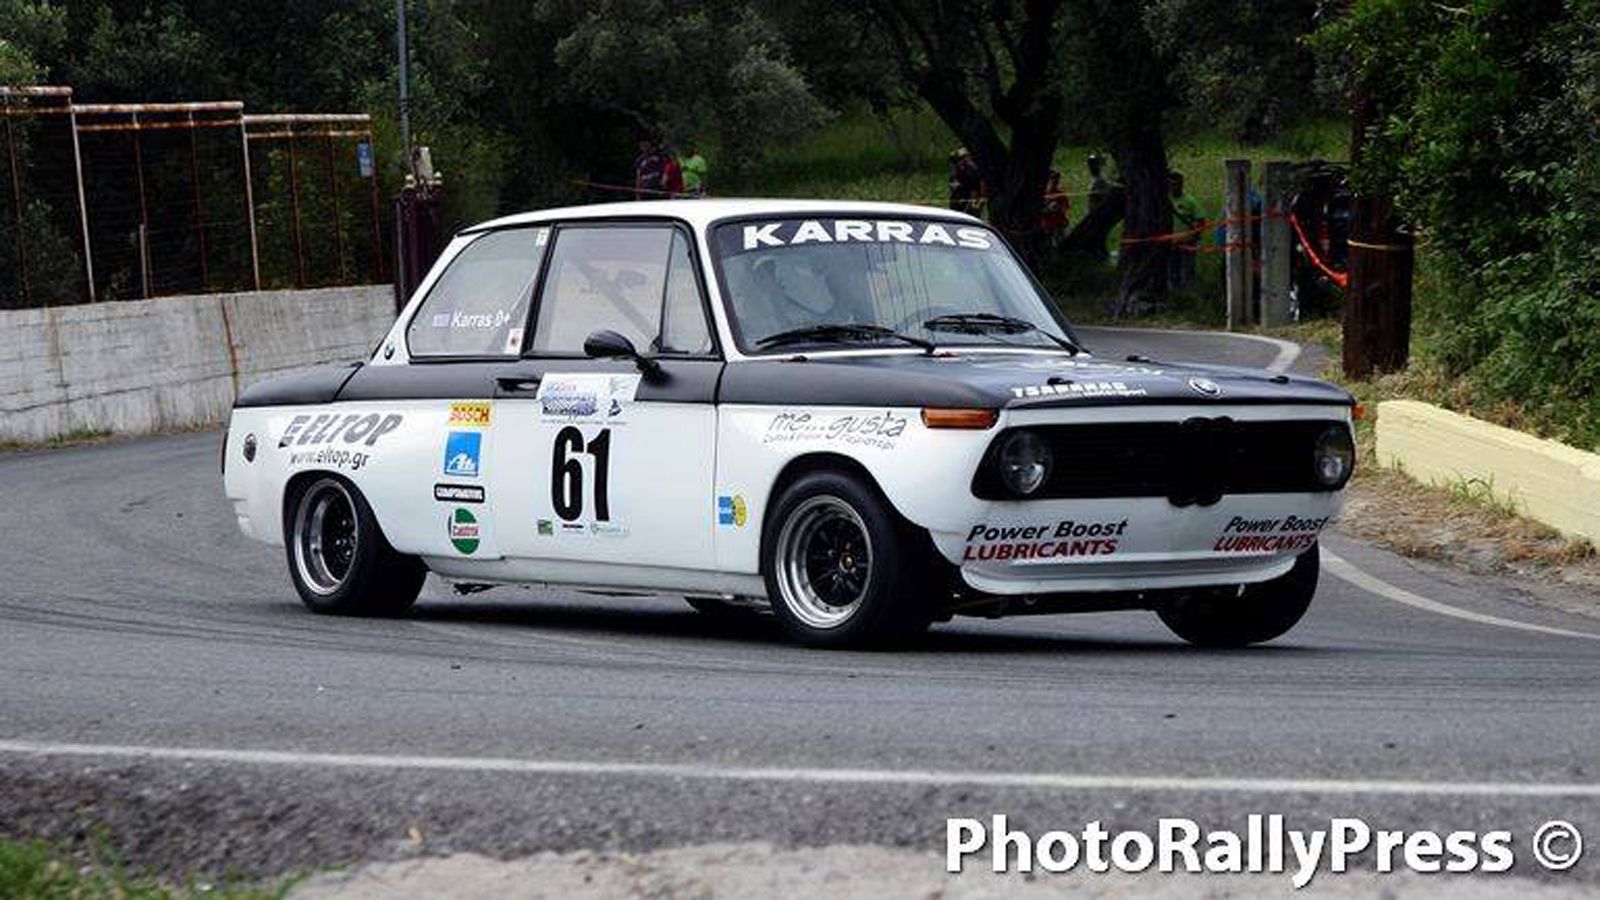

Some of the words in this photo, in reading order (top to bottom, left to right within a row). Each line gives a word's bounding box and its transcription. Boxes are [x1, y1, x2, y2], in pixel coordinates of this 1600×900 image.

[743, 220, 990, 249] KARRAS
[450, 309, 492, 328] Karras
[450, 407, 489, 422] BOSCH
[296, 413, 403, 446] ELTOP
[552, 426, 611, 521] 61
[966, 525, 1049, 542] Power
[1053, 519, 1128, 538] Boost
[1223, 516, 1279, 532] Power
[1279, 515, 1329, 532] Boost
[963, 538, 1117, 561] LUBRICANTS
[1213, 533, 1316, 551] LUBRICANTS
